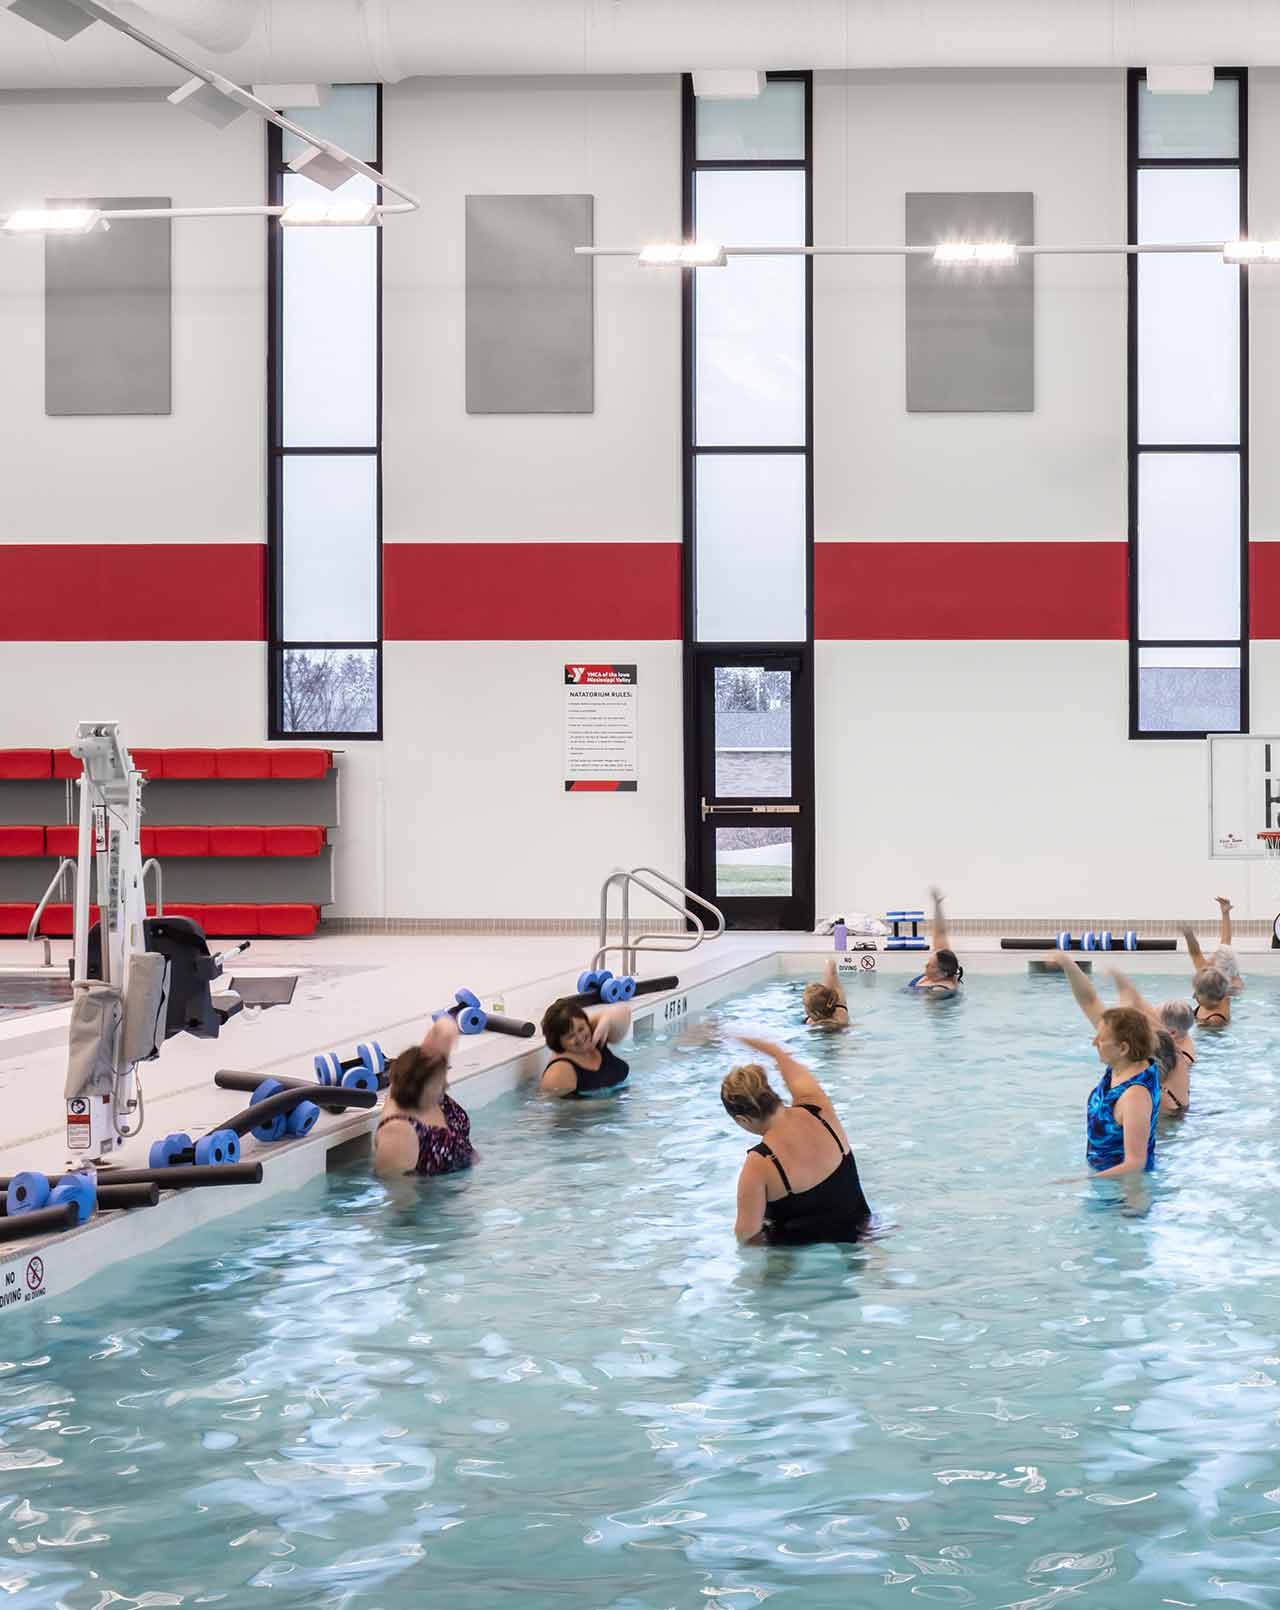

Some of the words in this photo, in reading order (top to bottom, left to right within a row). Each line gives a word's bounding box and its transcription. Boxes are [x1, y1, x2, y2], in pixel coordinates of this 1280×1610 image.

[669, 1000, 676, 1019] FT
[682, 996, 687, 1013] IN
[5, 1271, 15, 1287] NO
